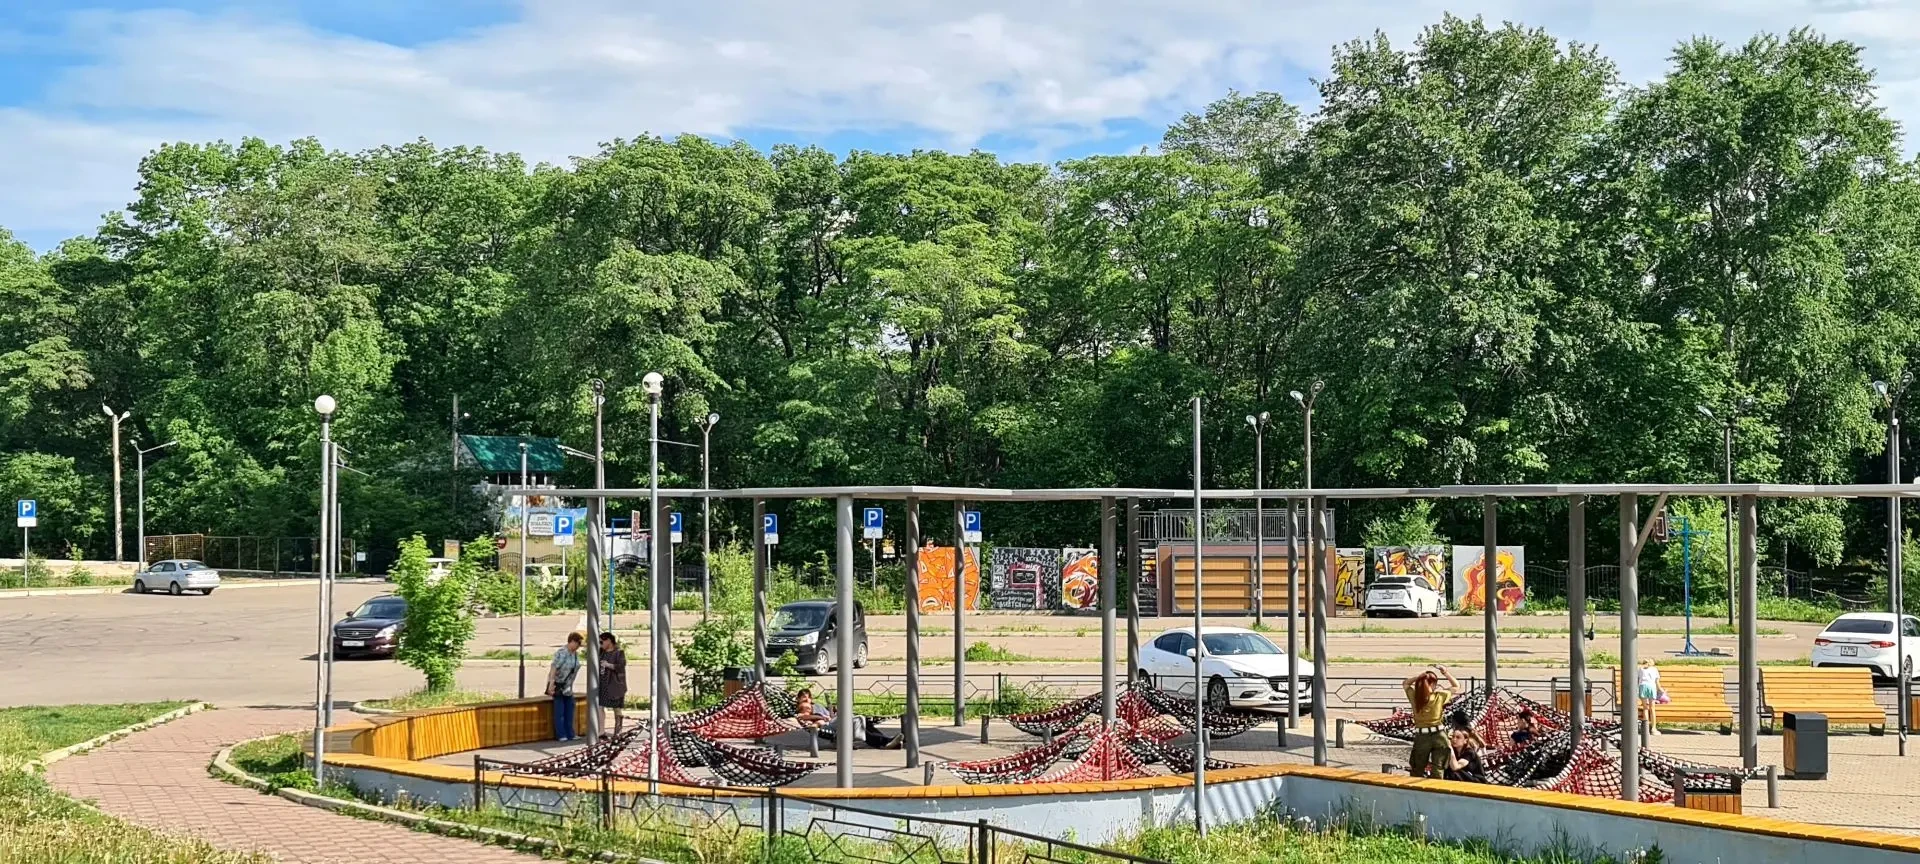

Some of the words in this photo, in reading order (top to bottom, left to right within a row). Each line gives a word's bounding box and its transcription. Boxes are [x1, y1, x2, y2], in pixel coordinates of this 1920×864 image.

[22, 502, 32, 516] P
[558, 517, 570, 532] P
[764, 516, 773, 532] P
[868, 510, 879, 526] P
[966, 513, 977, 529] P
